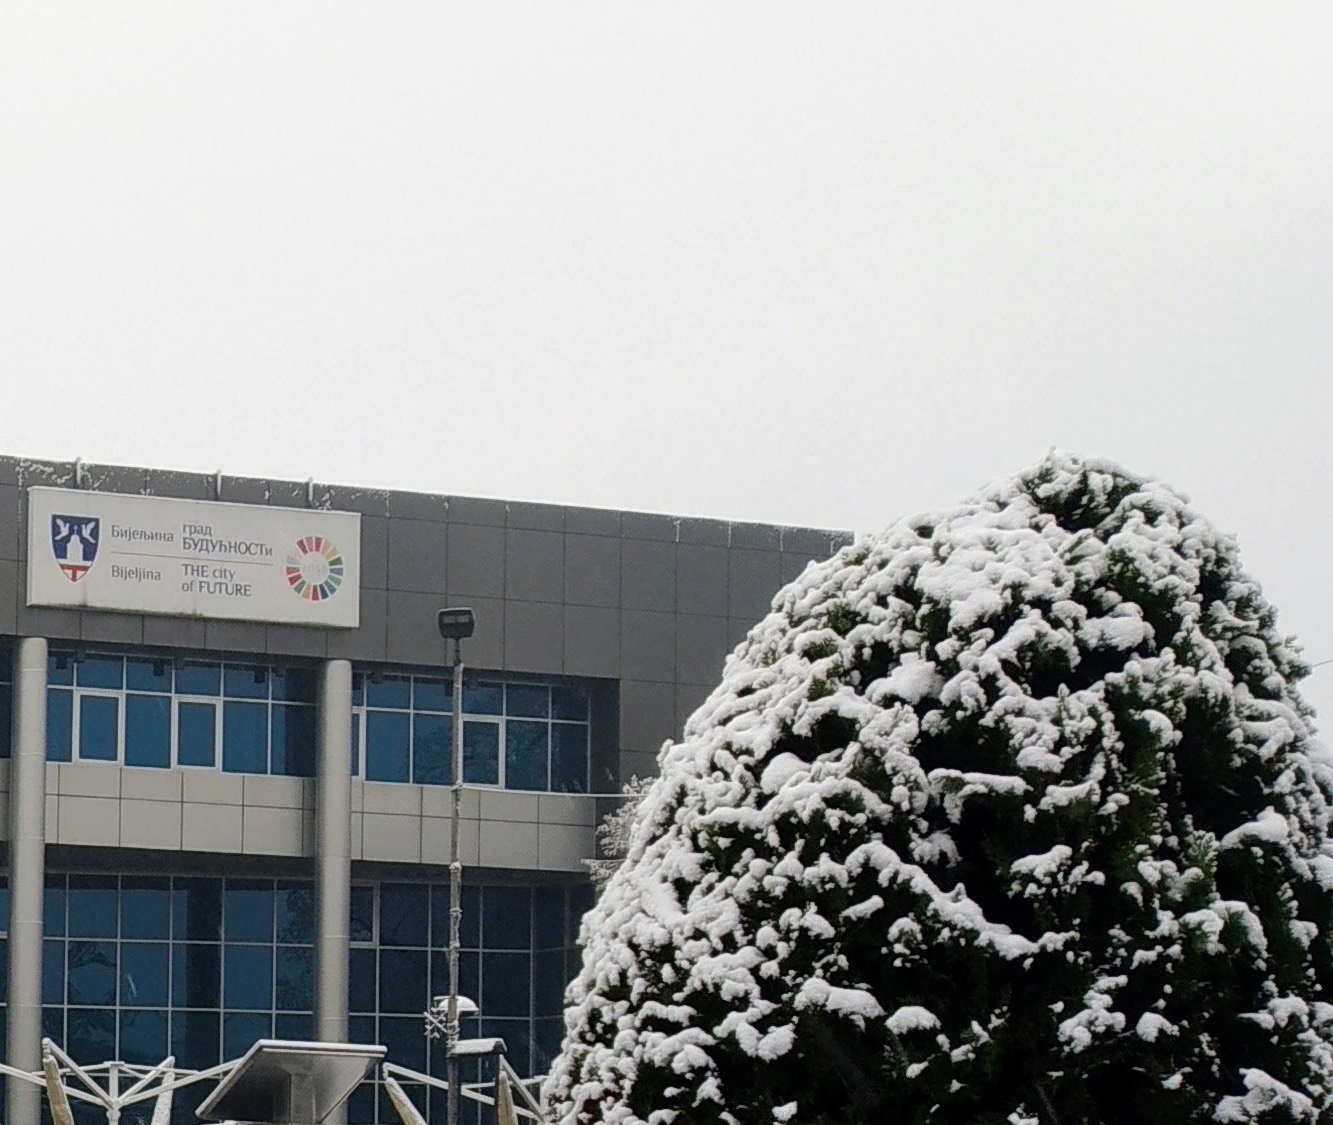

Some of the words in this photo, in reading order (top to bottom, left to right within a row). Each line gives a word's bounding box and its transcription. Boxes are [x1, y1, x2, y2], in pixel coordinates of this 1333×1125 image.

[111, 524, 174, 542] Бијељина
[182, 524, 213, 537] град
[111, 564, 162, 582] Bijeljina
[181, 563, 210, 578] THE
[212, 567, 236, 582] city
[181, 579, 196, 592] of
[198, 580, 252, 597] FUTURE
